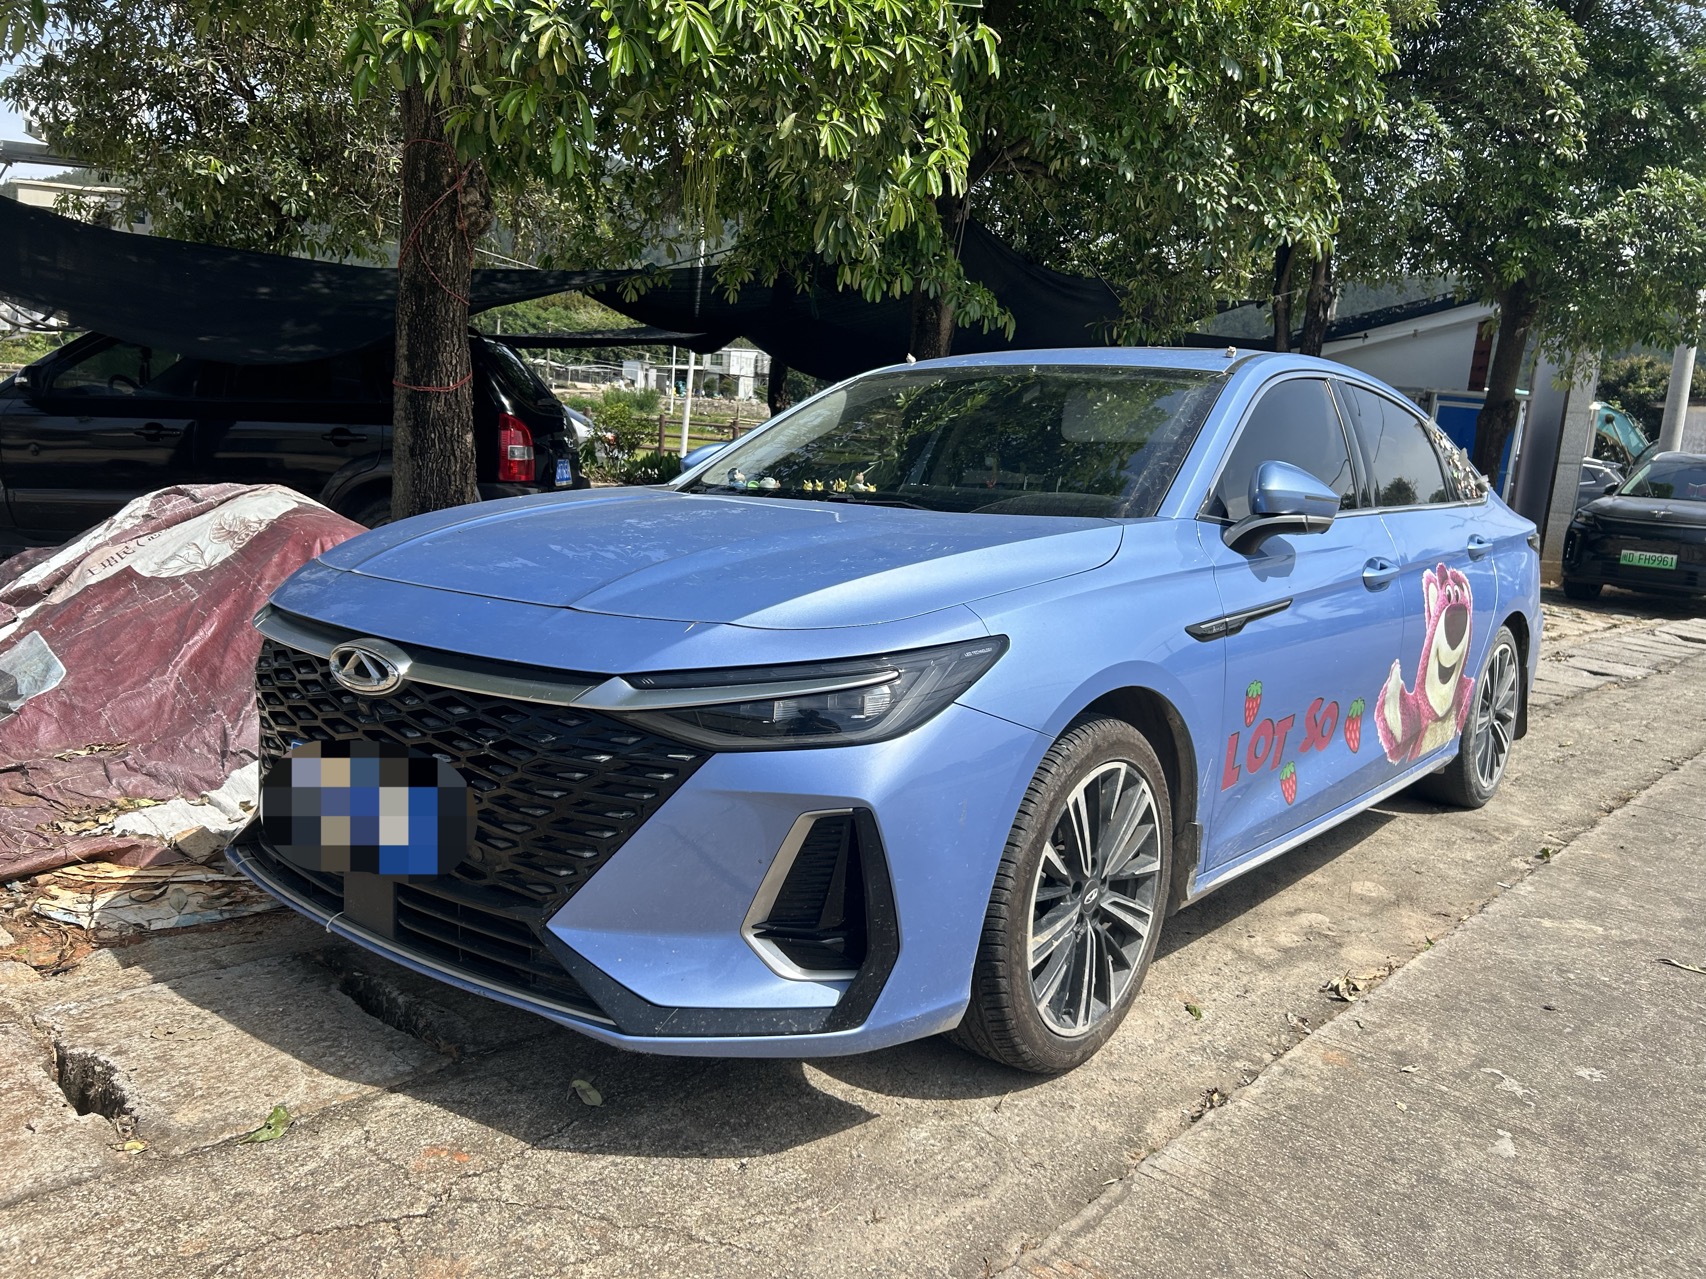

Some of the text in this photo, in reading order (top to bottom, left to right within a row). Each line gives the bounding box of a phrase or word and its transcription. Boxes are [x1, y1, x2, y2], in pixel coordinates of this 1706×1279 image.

[1637, 553, 1675, 567] FH9961
[1221, 697, 1340, 792] LOT SO
